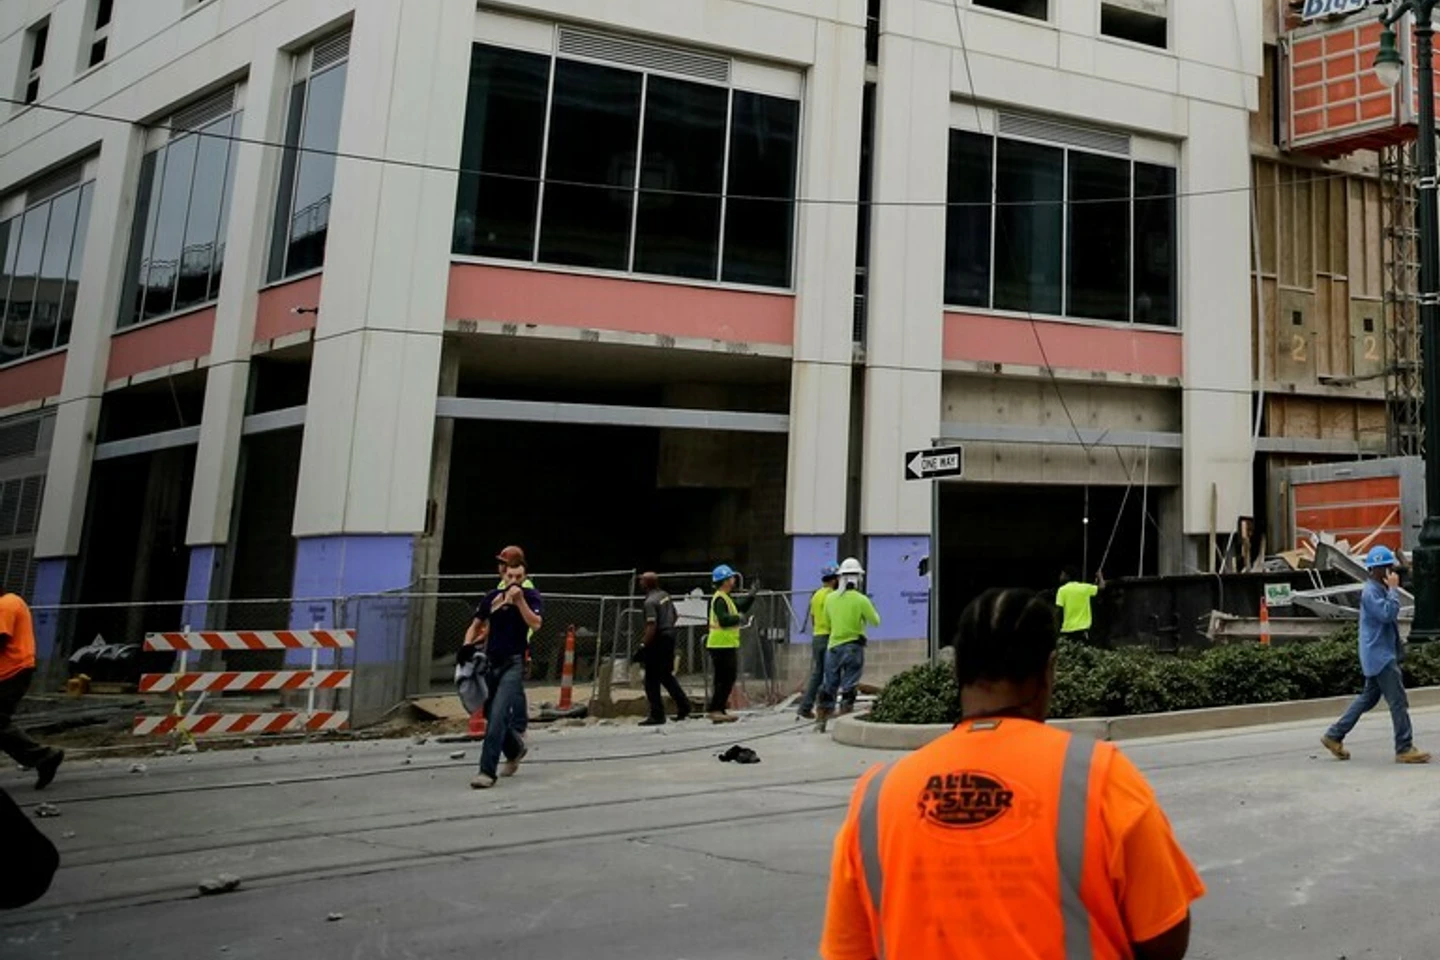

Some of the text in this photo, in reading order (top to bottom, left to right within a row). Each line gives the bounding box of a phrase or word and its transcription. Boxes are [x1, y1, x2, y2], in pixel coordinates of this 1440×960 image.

[1290, 335, 1379, 363] 2 2
[921, 456, 955, 470] ONE WAY
[925, 773, 973, 789] ALL
[942, 790, 1013, 808] STAR
